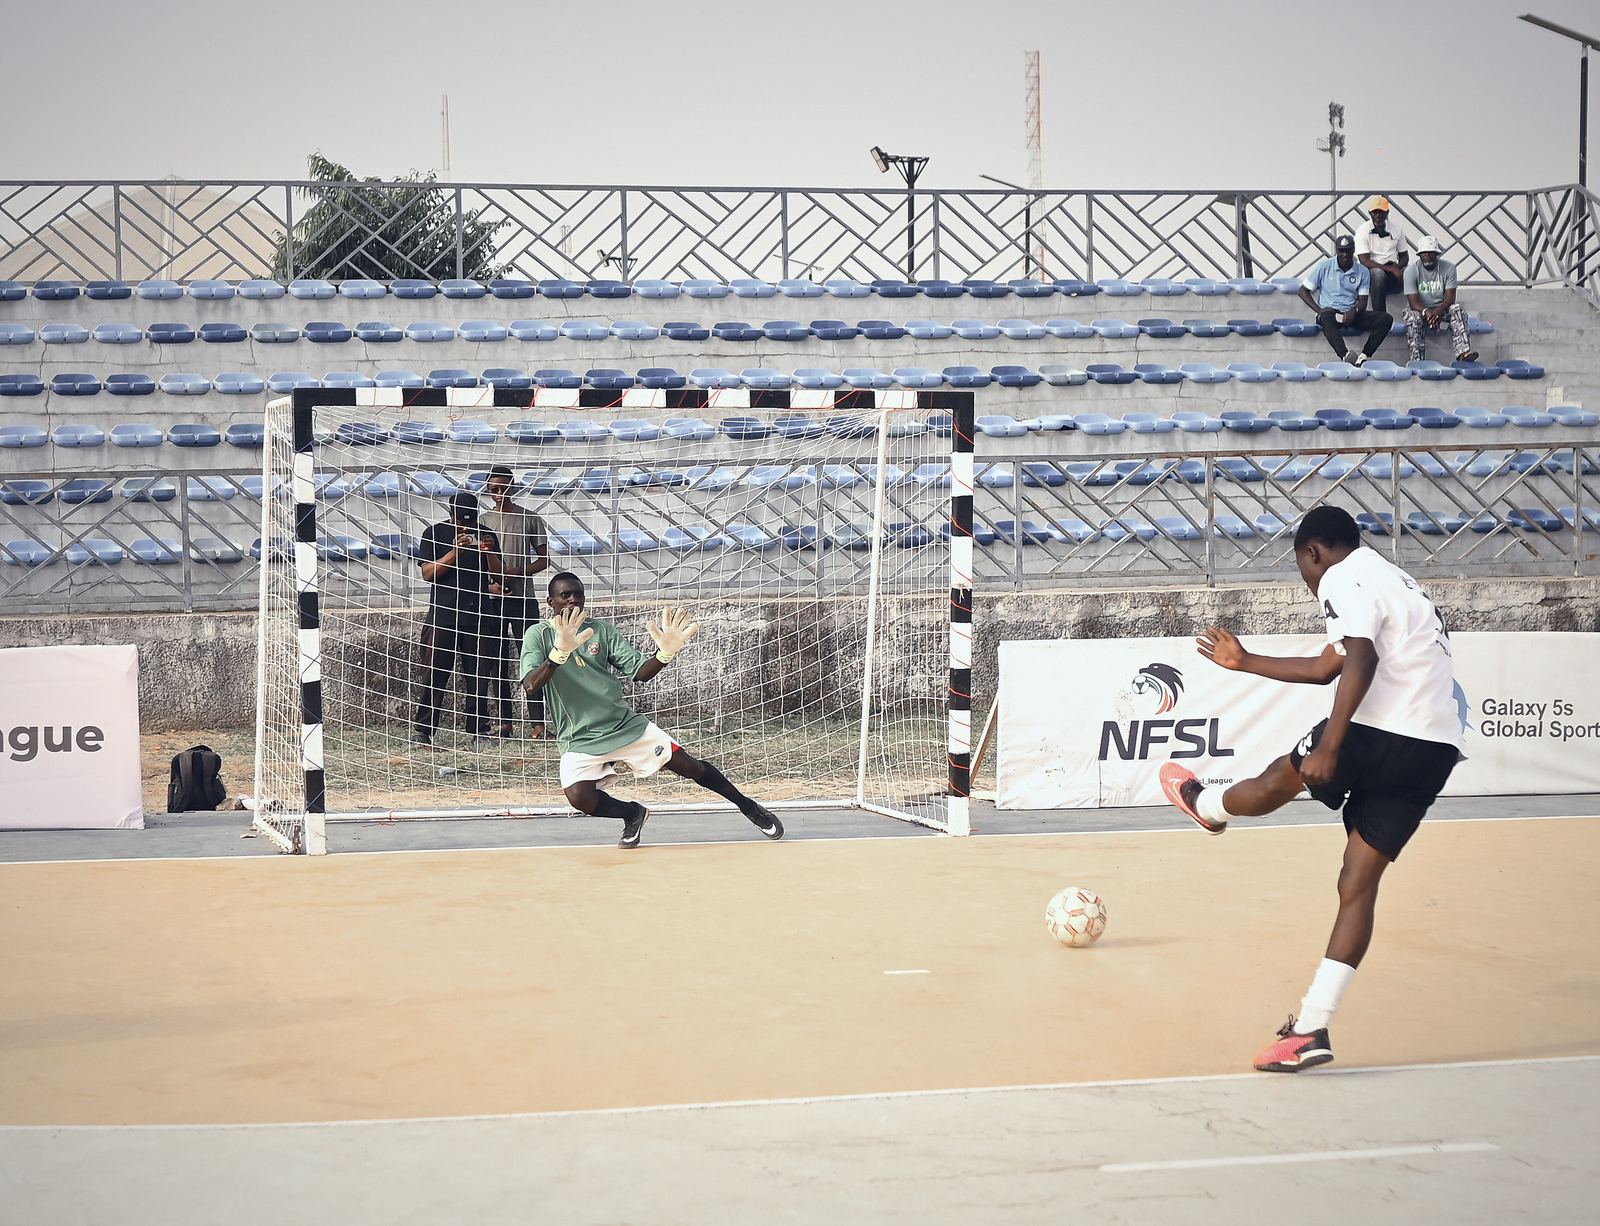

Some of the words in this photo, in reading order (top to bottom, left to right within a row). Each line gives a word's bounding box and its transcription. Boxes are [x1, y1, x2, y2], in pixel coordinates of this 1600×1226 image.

[1481, 698, 1548, 720] Galaxy
[1552, 699, 1574, 717] 5s
[0, 724, 105, 763] gue
[1098, 718, 1234, 760] NFSL
[1480, 719, 1543, 738] Global
